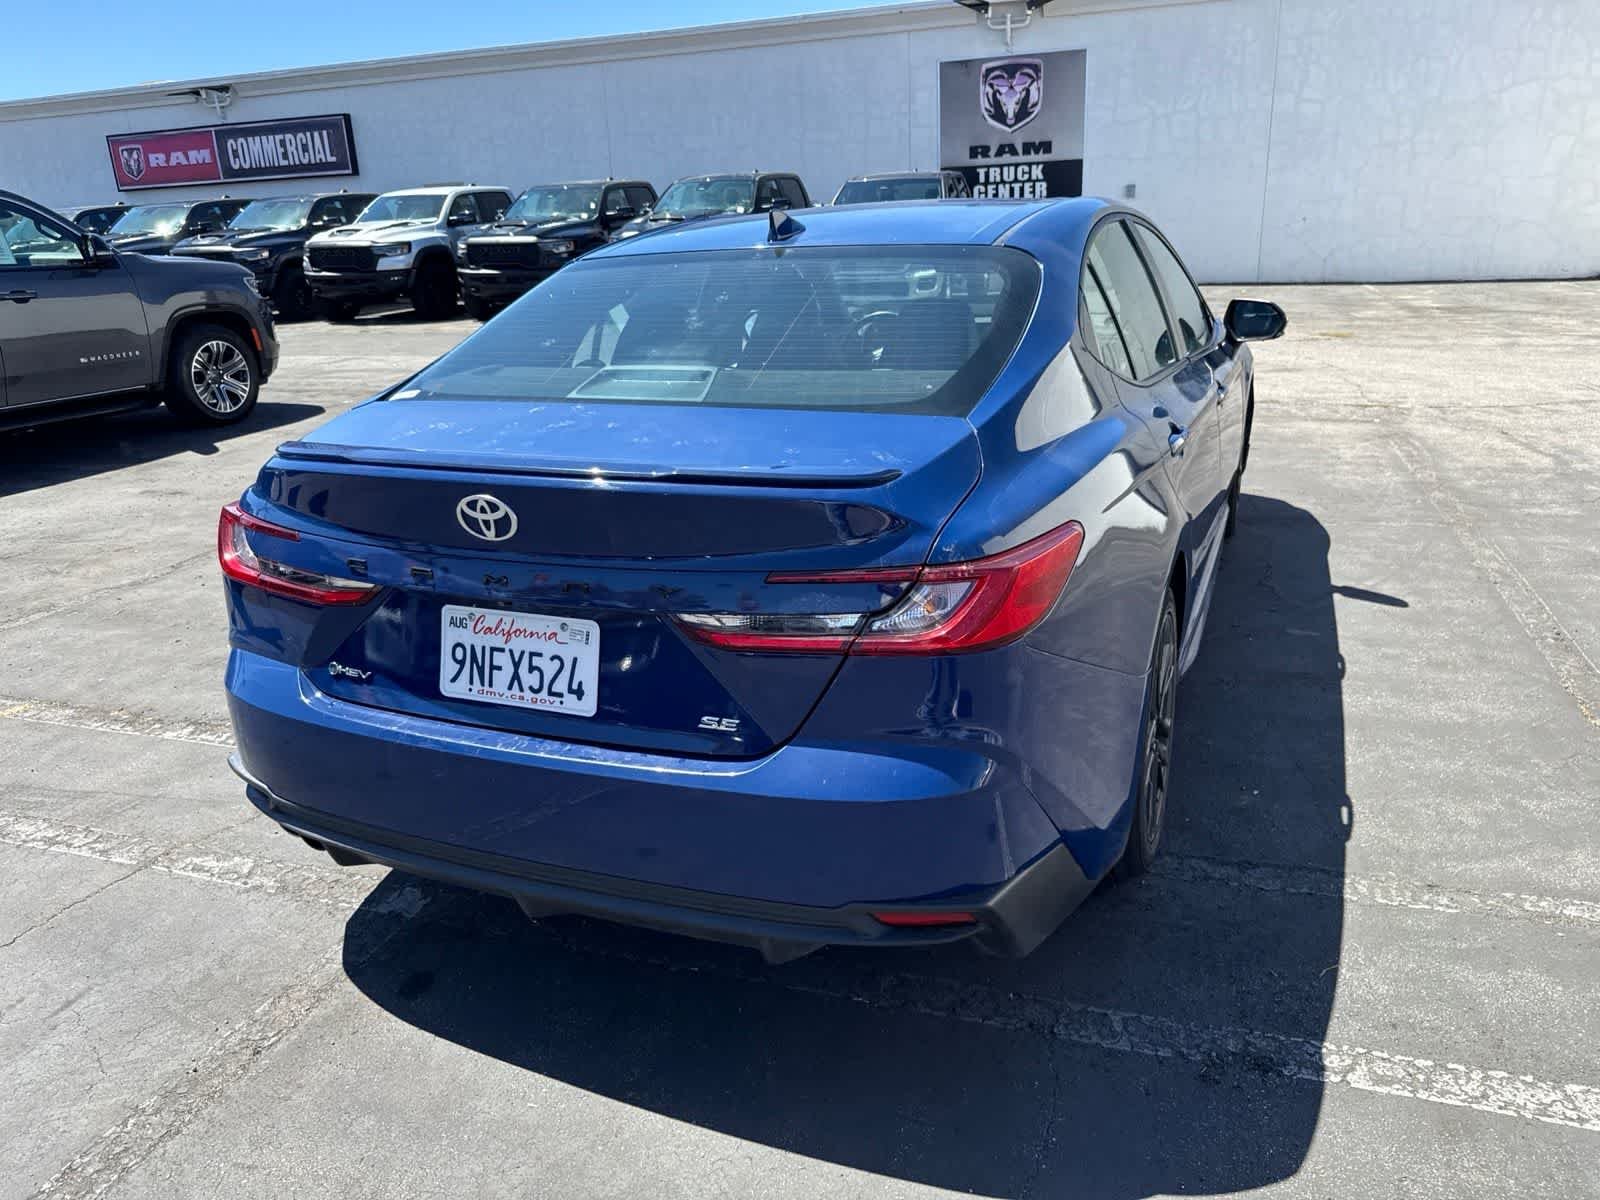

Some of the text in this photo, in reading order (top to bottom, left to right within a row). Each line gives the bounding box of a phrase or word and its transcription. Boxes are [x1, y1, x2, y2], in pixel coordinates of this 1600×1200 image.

[147, 129, 337, 170] RAM COMMERCIAL
[969, 140, 1053, 160] RAM
[976, 164, 1045, 184] TRUCK
[973, 181, 1048, 199] CENTER
[449, 615, 468, 630] AUG
[472, 614, 569, 645] California
[449, 641, 585, 701] 9NFX524
[476, 688, 556, 705] dmv.ca.gov
[697, 715, 741, 732] SE
